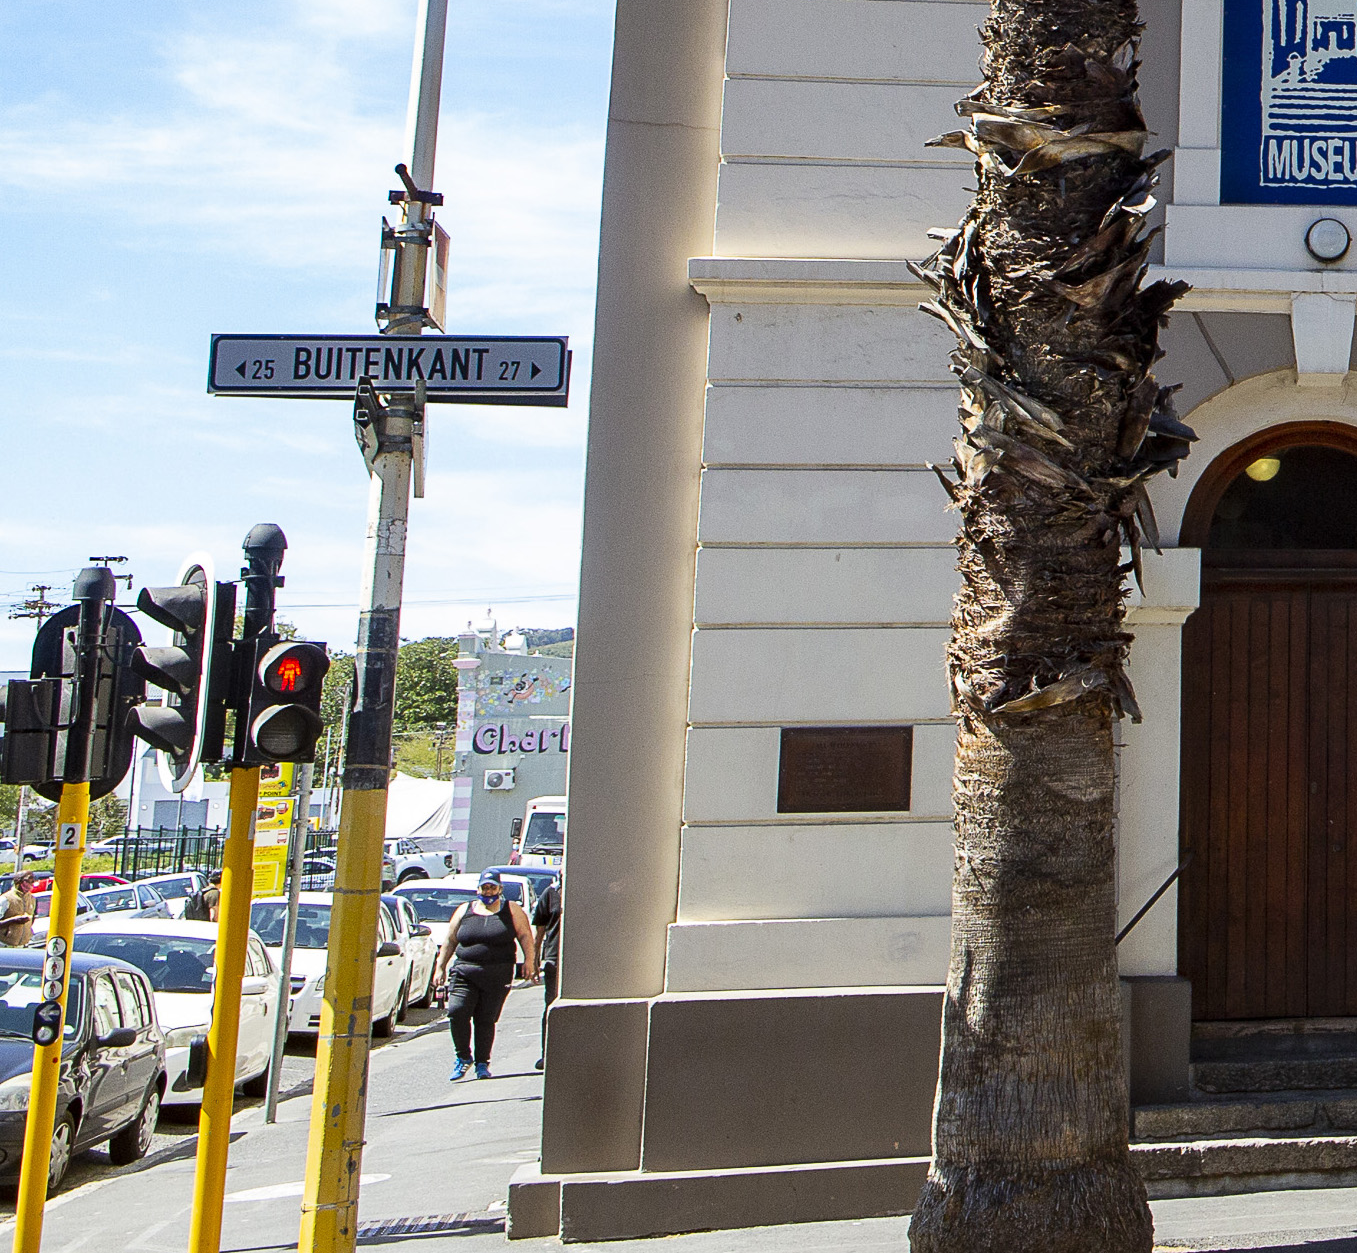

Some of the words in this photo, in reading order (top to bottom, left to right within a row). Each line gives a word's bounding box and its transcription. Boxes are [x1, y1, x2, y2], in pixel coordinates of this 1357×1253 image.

[252, 360, 275, 380] 25
[293, 347, 489, 381] BUITENKANT
[499, 361, 521, 380] 27
[64, 827, 75, 845] 2
